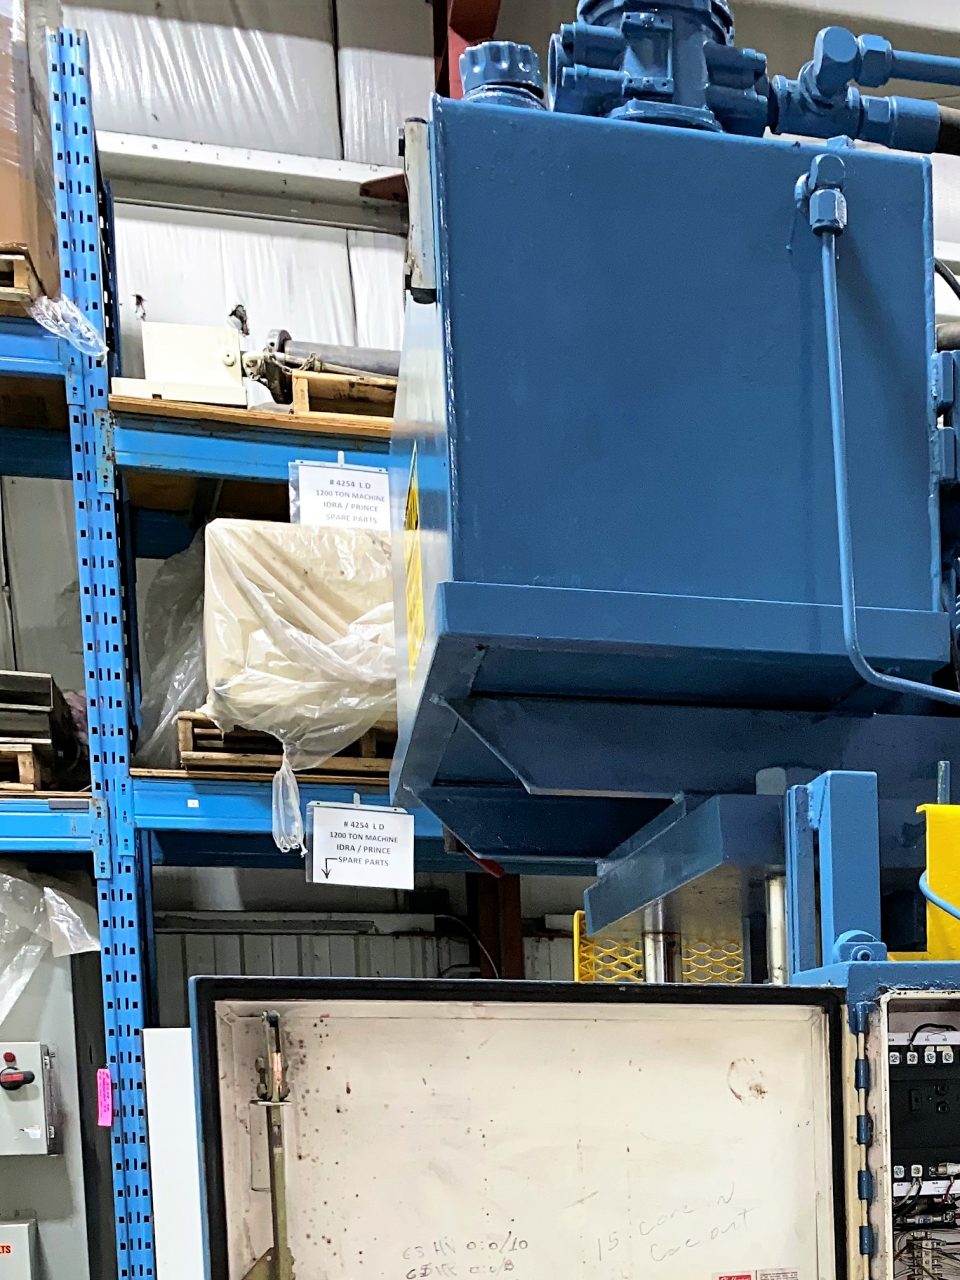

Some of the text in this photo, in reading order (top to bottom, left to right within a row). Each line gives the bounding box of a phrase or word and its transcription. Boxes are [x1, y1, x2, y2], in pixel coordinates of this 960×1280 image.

[336, 479, 355, 487] 4254
[351, 493, 385, 502] MACHINE
[323, 501, 343, 509] IDRA
[350, 503, 379, 512] PRINCE
[325, 513, 378, 524] SPARE PARTS
[350, 821, 369, 829] 4254
[330, 831, 347, 839] 1200
[365, 834, 398, 843] MACHINE
[336, 843, 356, 852] IDRA
[363, 846, 391, 855] PRINCE
[338, 856, 389, 867] SPARE PARTS
